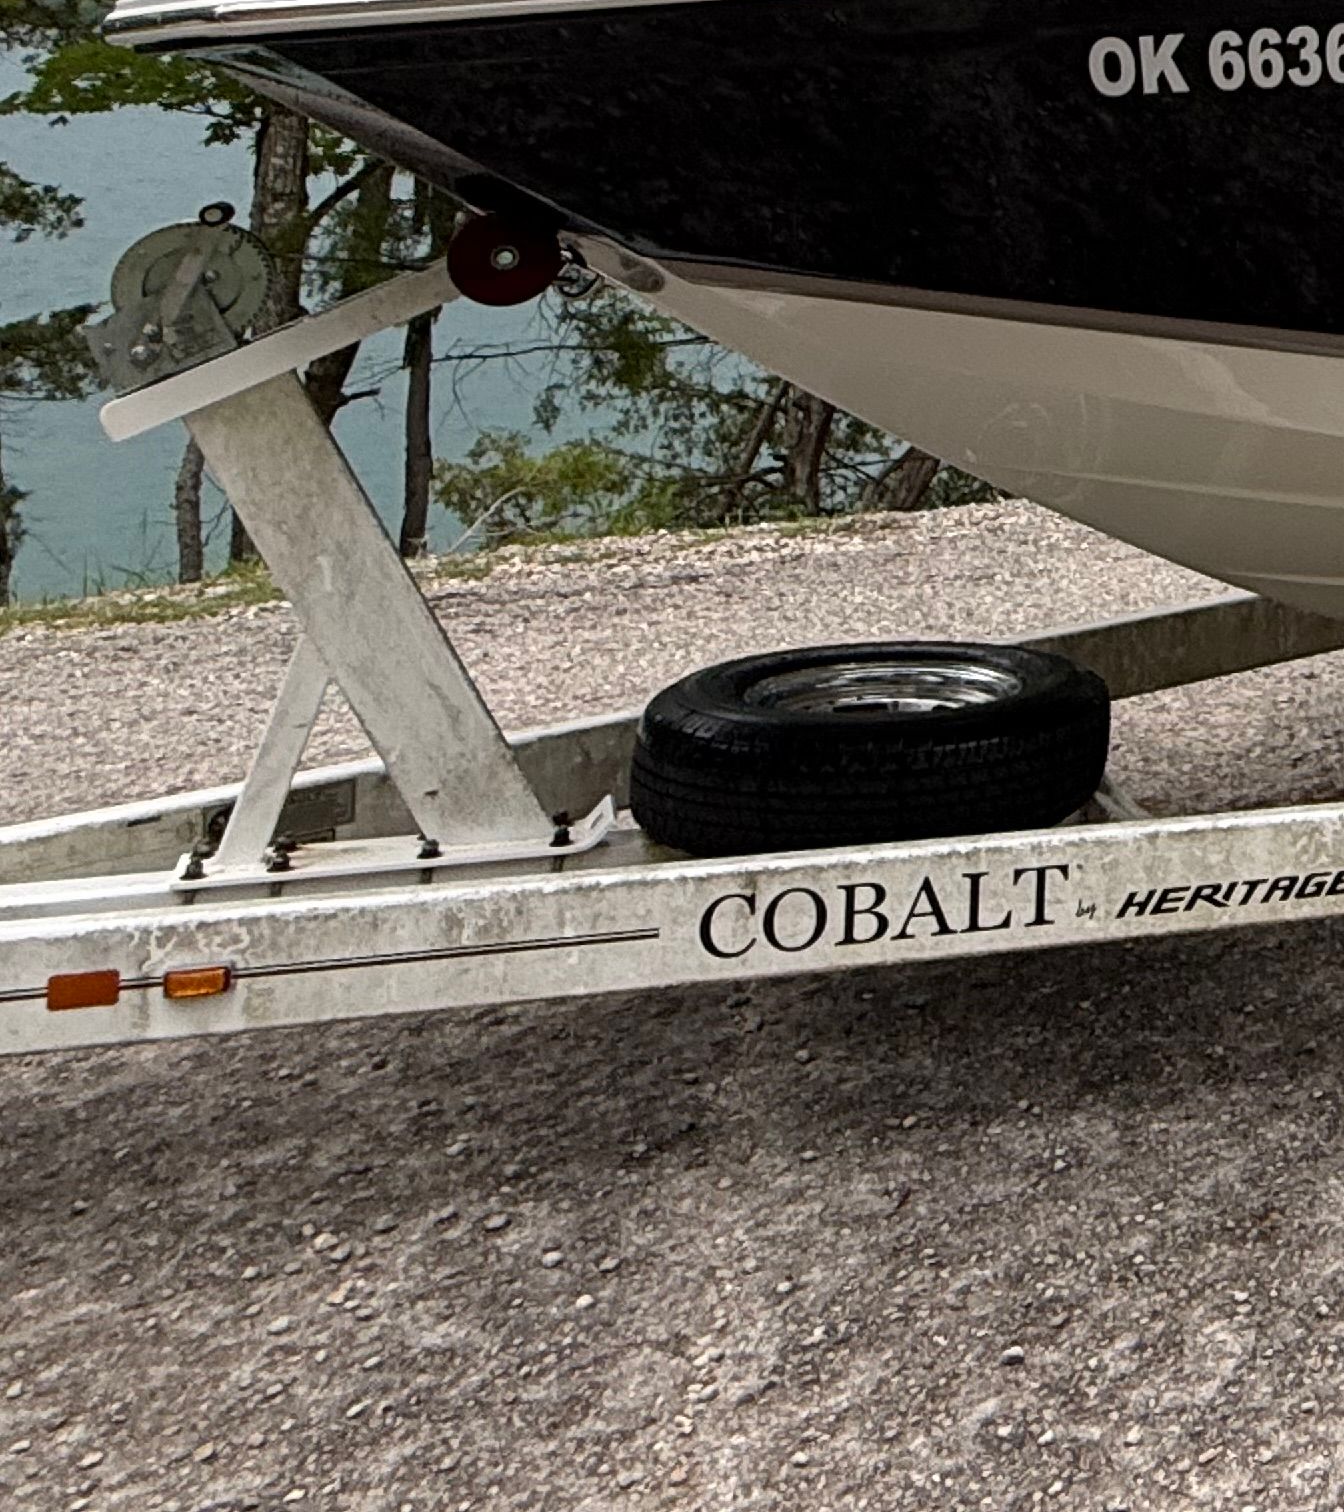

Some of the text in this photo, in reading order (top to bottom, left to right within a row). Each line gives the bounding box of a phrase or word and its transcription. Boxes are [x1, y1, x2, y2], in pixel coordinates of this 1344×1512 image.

[1088, 33, 1191, 97] OK
[698, 863, 1069, 959] COBALT
[1075, 897, 1097, 919] by
